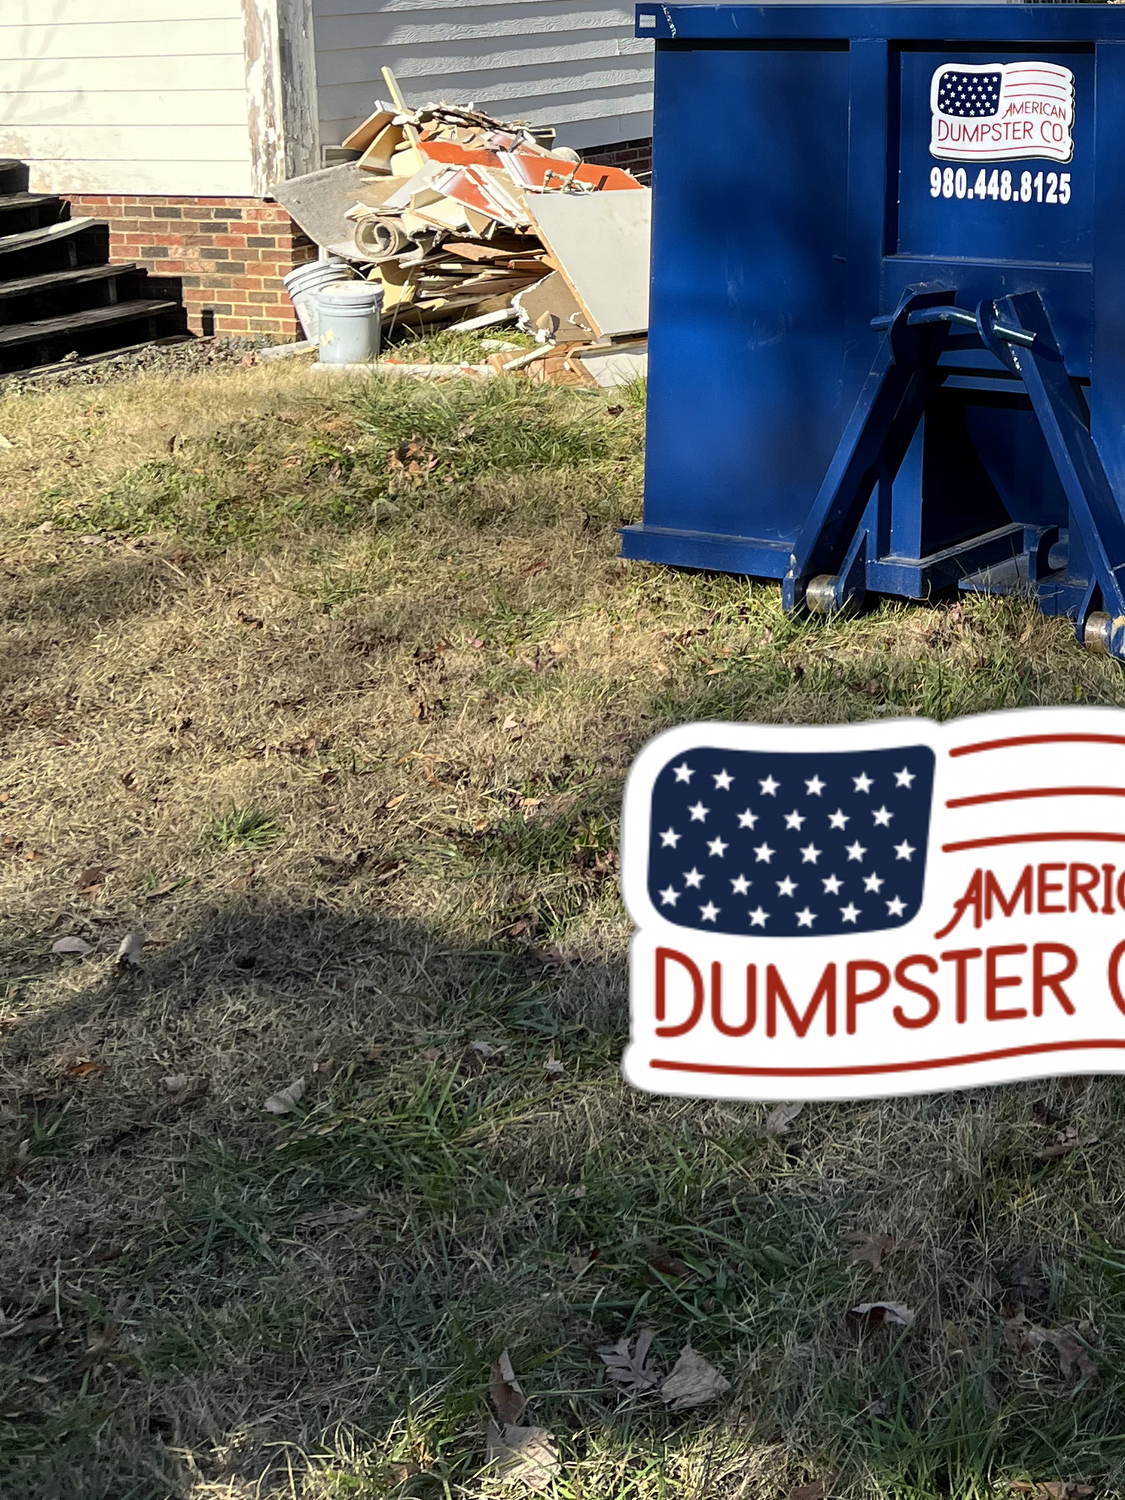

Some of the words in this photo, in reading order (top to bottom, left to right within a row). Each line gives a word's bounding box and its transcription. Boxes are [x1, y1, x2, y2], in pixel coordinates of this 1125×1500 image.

[1001, 100, 1067, 121] AMERICAN
[937, 119, 1034, 142] DUMPSTER
[1040, 120, 1067, 144] CO.
[930, 166, 1072, 205] 980.448.8125
